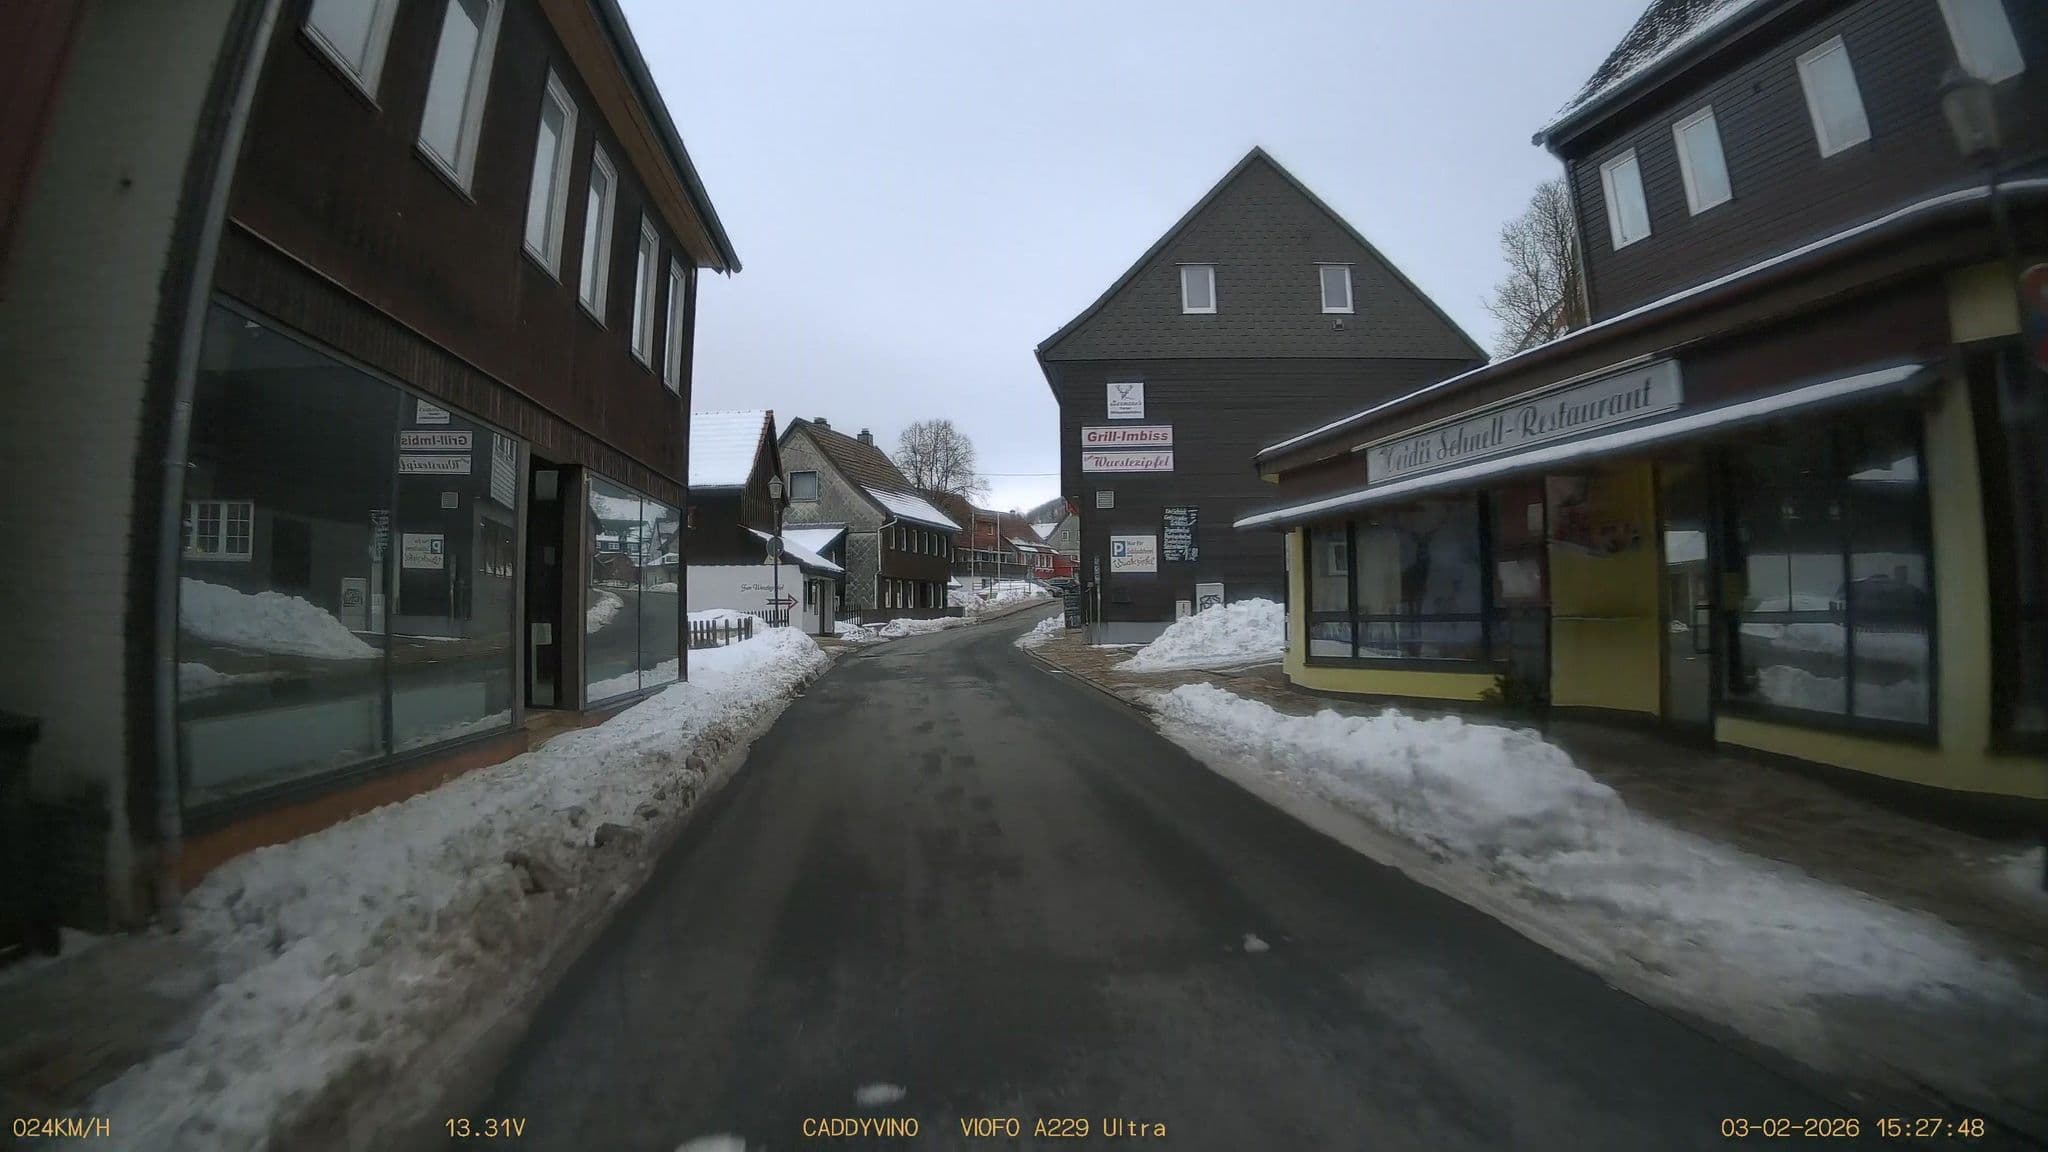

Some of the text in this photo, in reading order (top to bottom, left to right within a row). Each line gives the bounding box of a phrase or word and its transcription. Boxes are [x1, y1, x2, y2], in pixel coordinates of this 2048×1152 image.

[1435, 376, 1653, 462] Schnell-Restaurant
[1087, 430, 1169, 442] Grill-Imbiss
[1113, 542, 1124, 556] P
